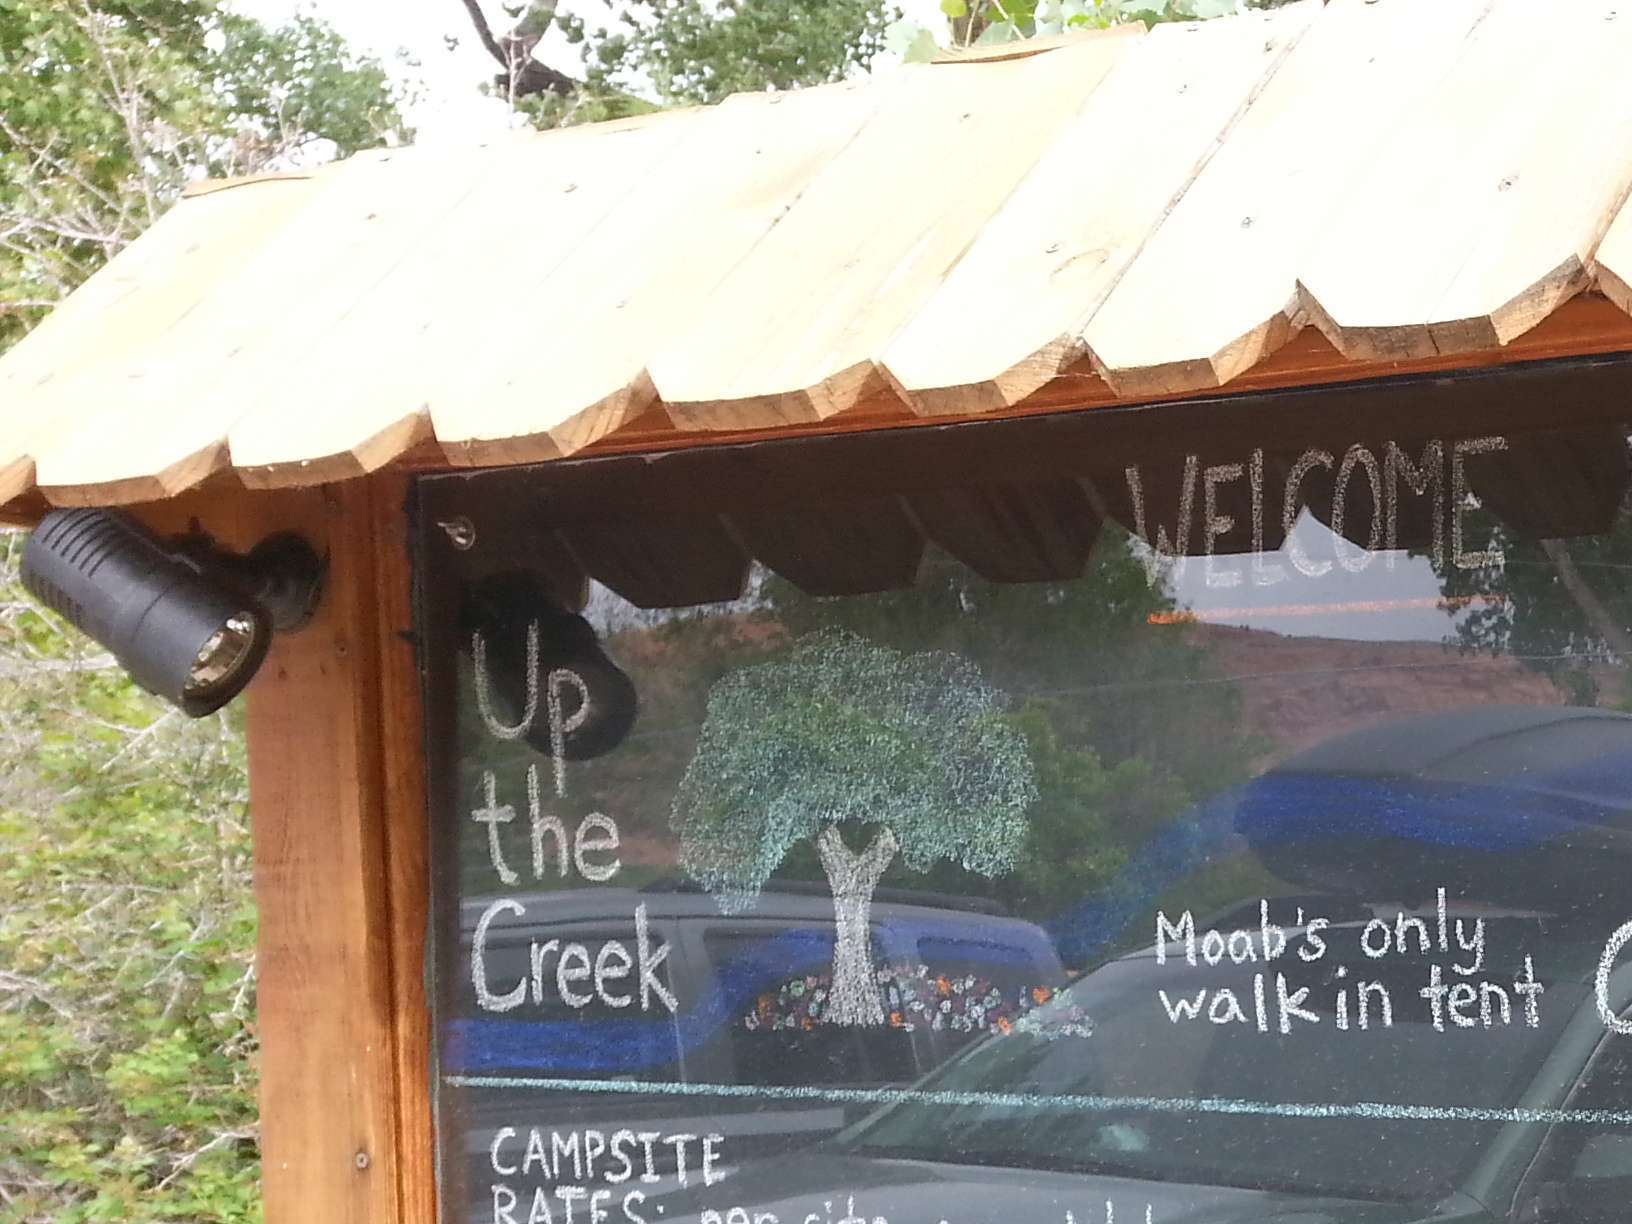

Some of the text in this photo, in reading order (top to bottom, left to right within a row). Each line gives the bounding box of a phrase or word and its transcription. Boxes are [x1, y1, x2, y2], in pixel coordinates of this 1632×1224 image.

[1126, 436, 1507, 588] WELCOME
[473, 619, 589, 797] Up
[472, 762, 622, 886] the
[471, 899, 678, 1012] Creek
[1154, 887, 1486, 975] Moab's only
[1159, 954, 1544, 1033] walk in tent
[490, 1126, 725, 1187] CAMPSITE
